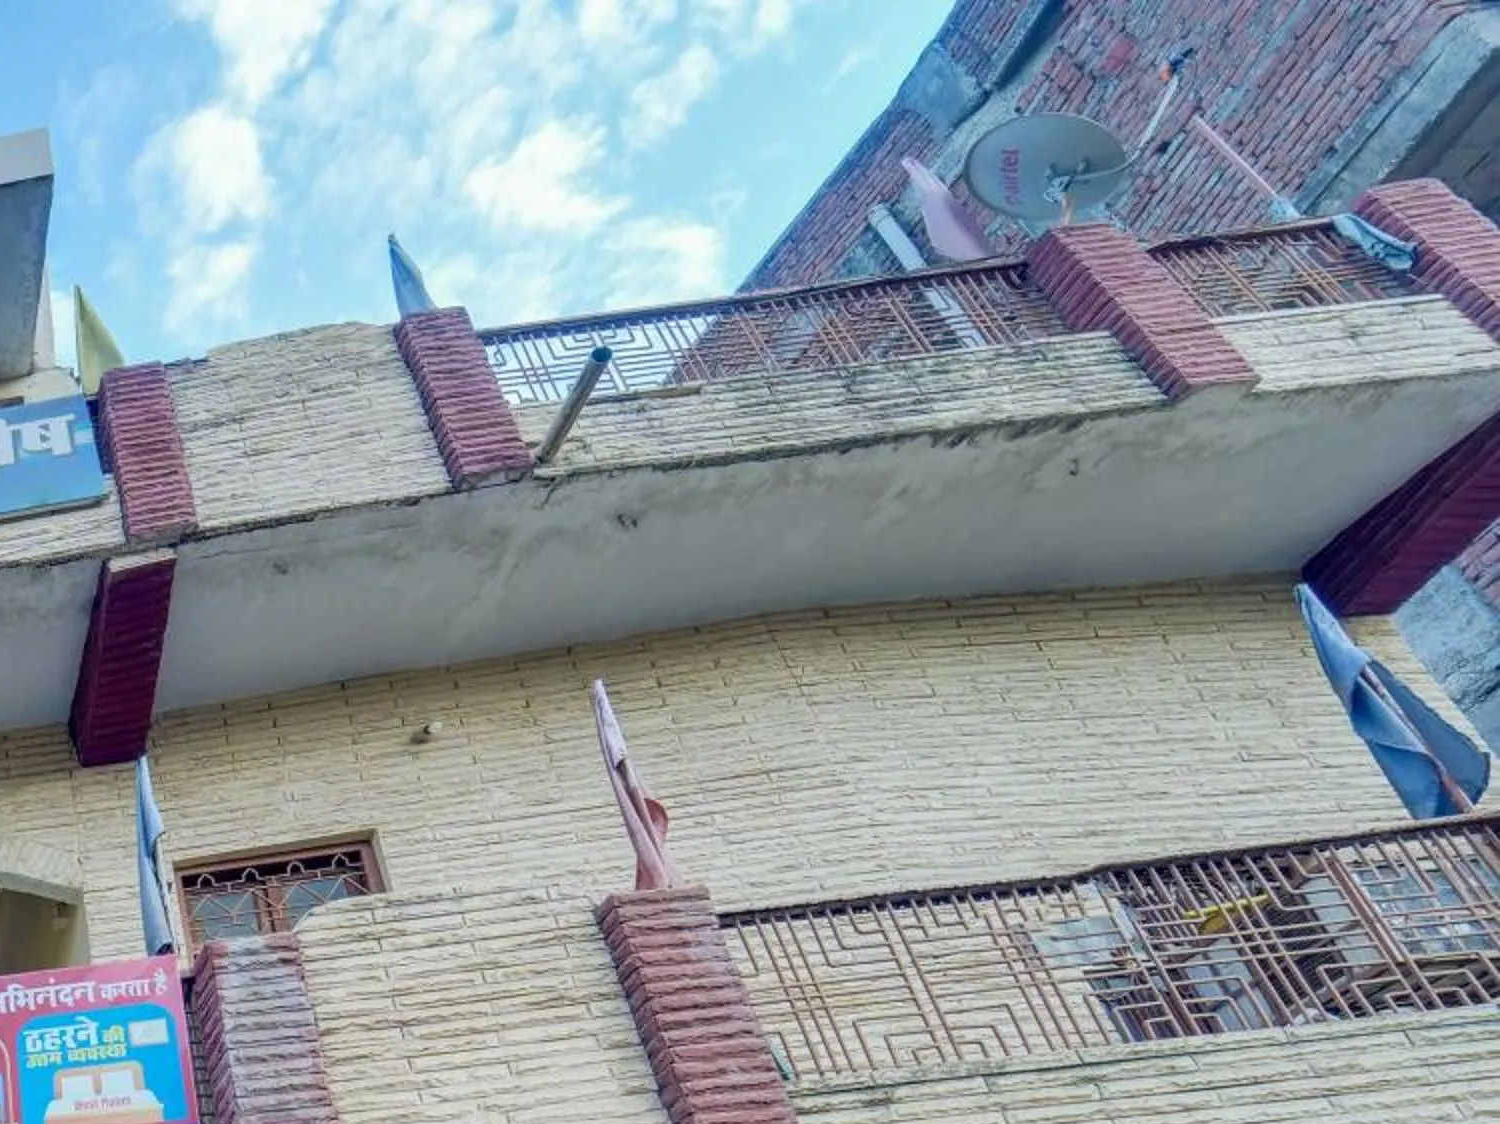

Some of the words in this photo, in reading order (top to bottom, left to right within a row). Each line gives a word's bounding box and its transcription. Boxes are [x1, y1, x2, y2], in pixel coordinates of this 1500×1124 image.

[99, 977, 149, 1001] करता
[150, 968, 168, 996] है
[23, 1015, 100, 1053] ठहरने
[102, 1024, 126, 1043] की
